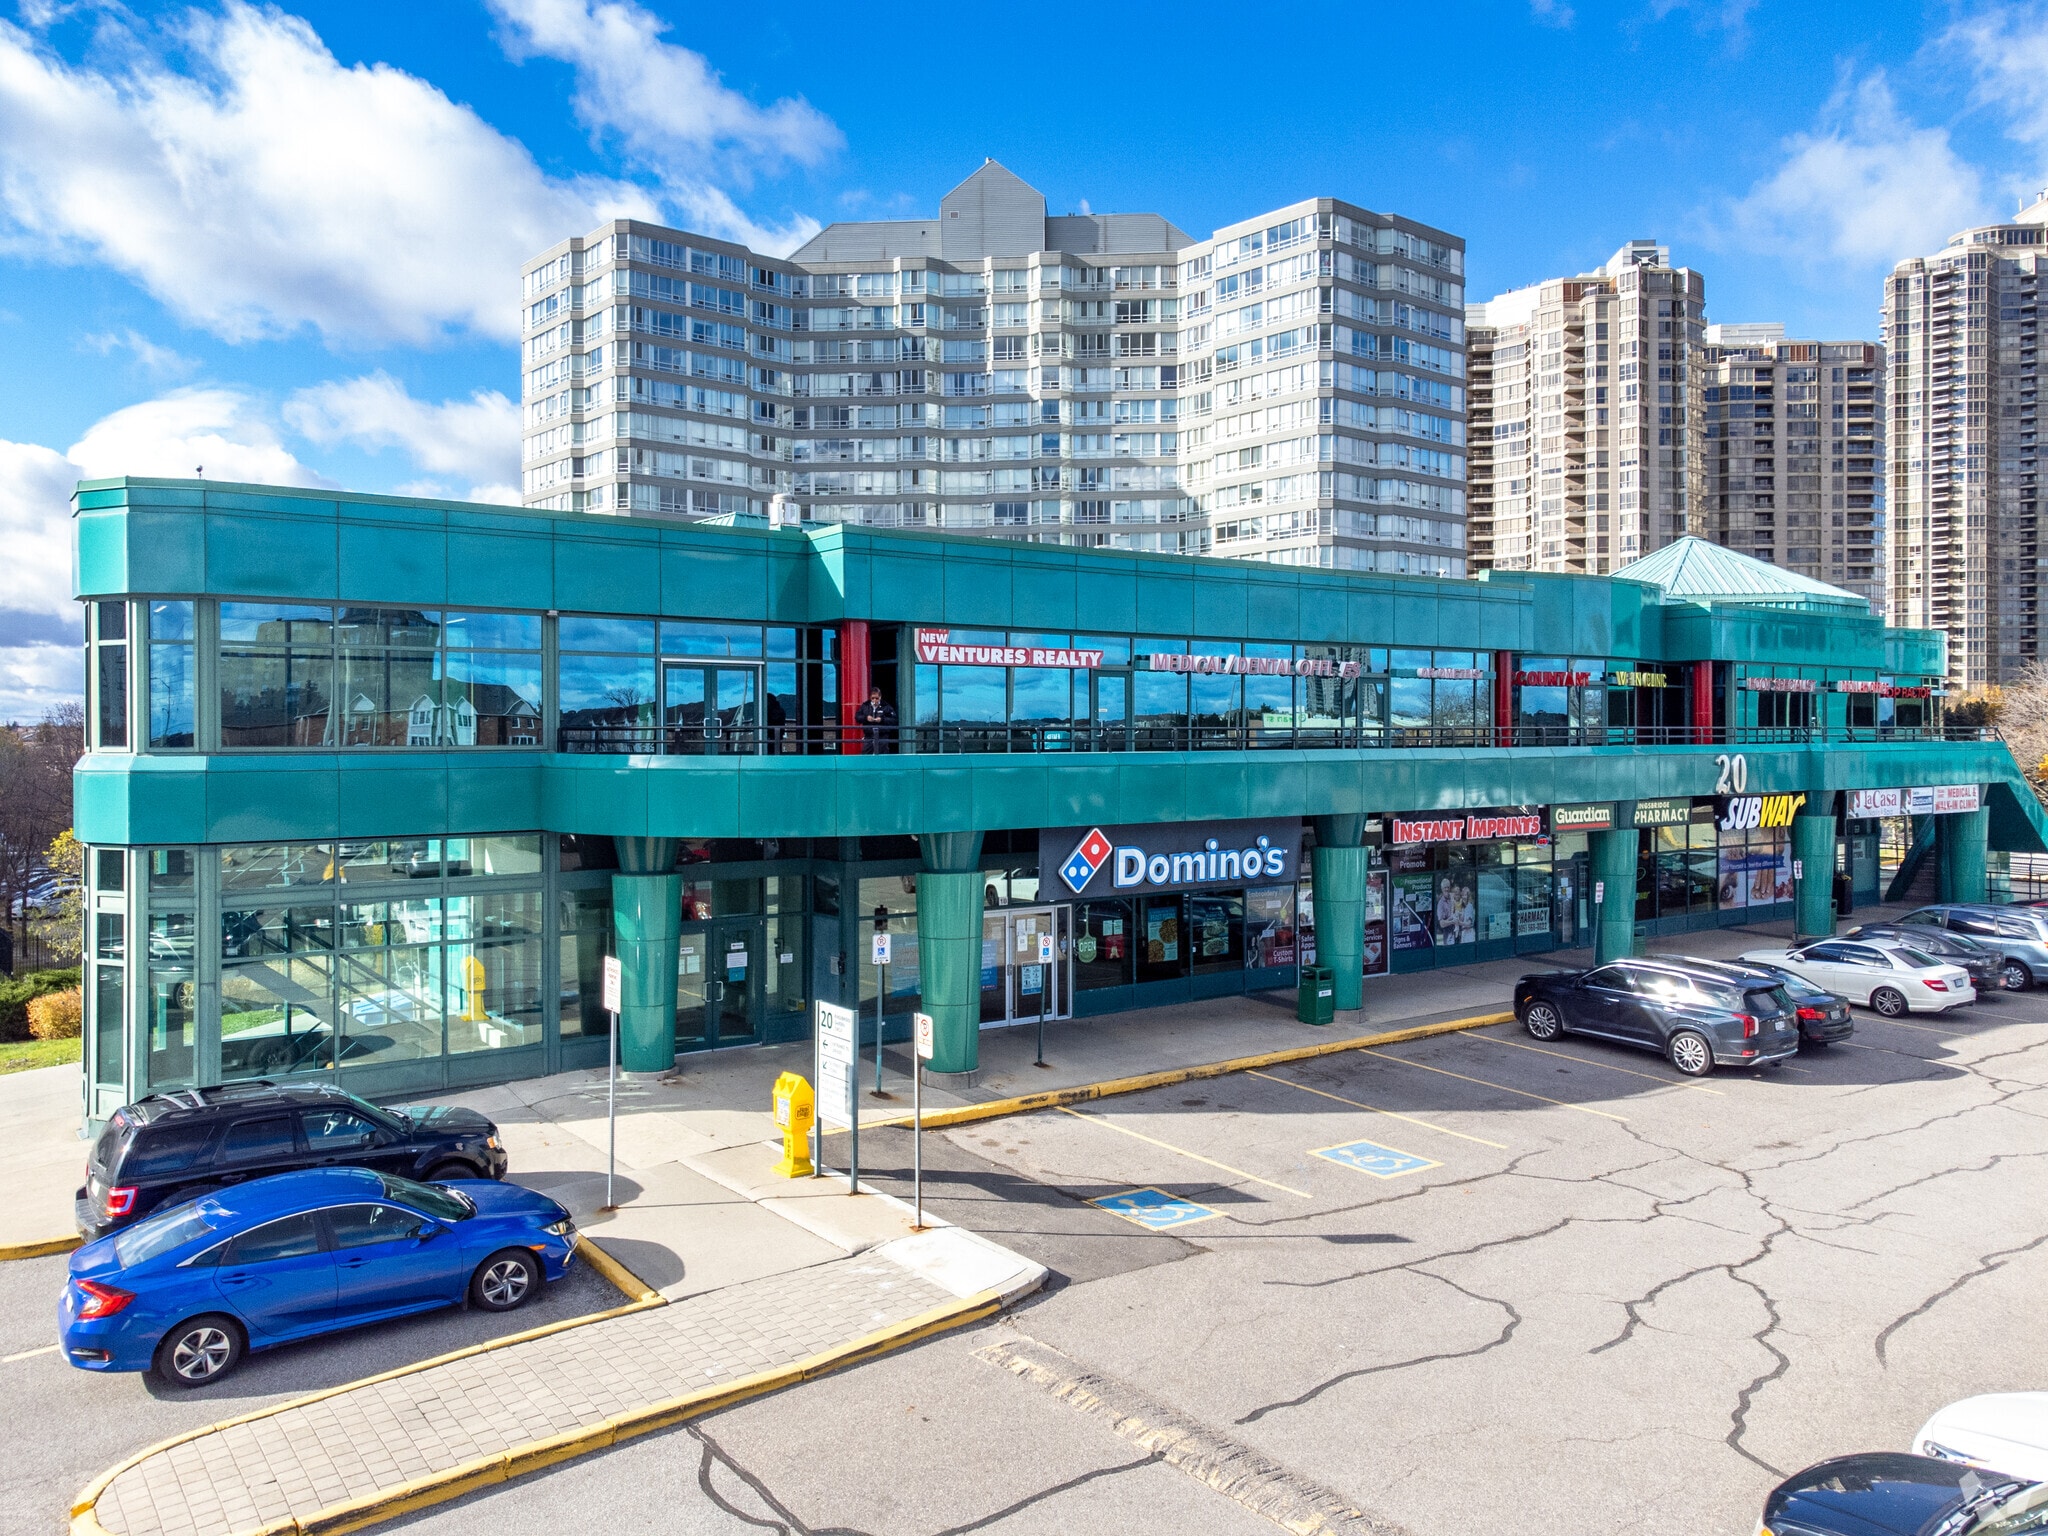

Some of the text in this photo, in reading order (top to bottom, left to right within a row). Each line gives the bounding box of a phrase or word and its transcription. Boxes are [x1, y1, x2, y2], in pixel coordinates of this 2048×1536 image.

[921, 633, 948, 644] NEW
[922, 645, 1103, 667] VENTURES REALTY
[1153, 654, 1295, 675] MEDICAL/DENTAL
[1512, 671, 1591, 686] COUNTANT
[1715, 754, 1747, 794] 20
[1864, 790, 1897, 809] LaCasa
[1947, 787, 1971, 798] MEDICAL
[1637, 801, 1670, 809] INGSBRIDGE
[1960, 799, 1977, 809] CLINIC
[1555, 806, 1611, 824] Guardian
[1634, 808, 1690, 824] PHARMACY
[1721, 793, 1806, 831] SUBWAY
[1393, 815, 1541, 844] INSTANT IMPRINTS
[1113, 835, 1286, 889] Domino's
[1400, 860, 1426, 868] Promote
[1404, 877, 1433, 885] Promotional
[1518, 909, 1548, 923] PHARMACY
[1301, 934, 1315, 942] Safet
[1272, 949, 1294, 957] Custom
[821, 1010, 833, 1029] 20
